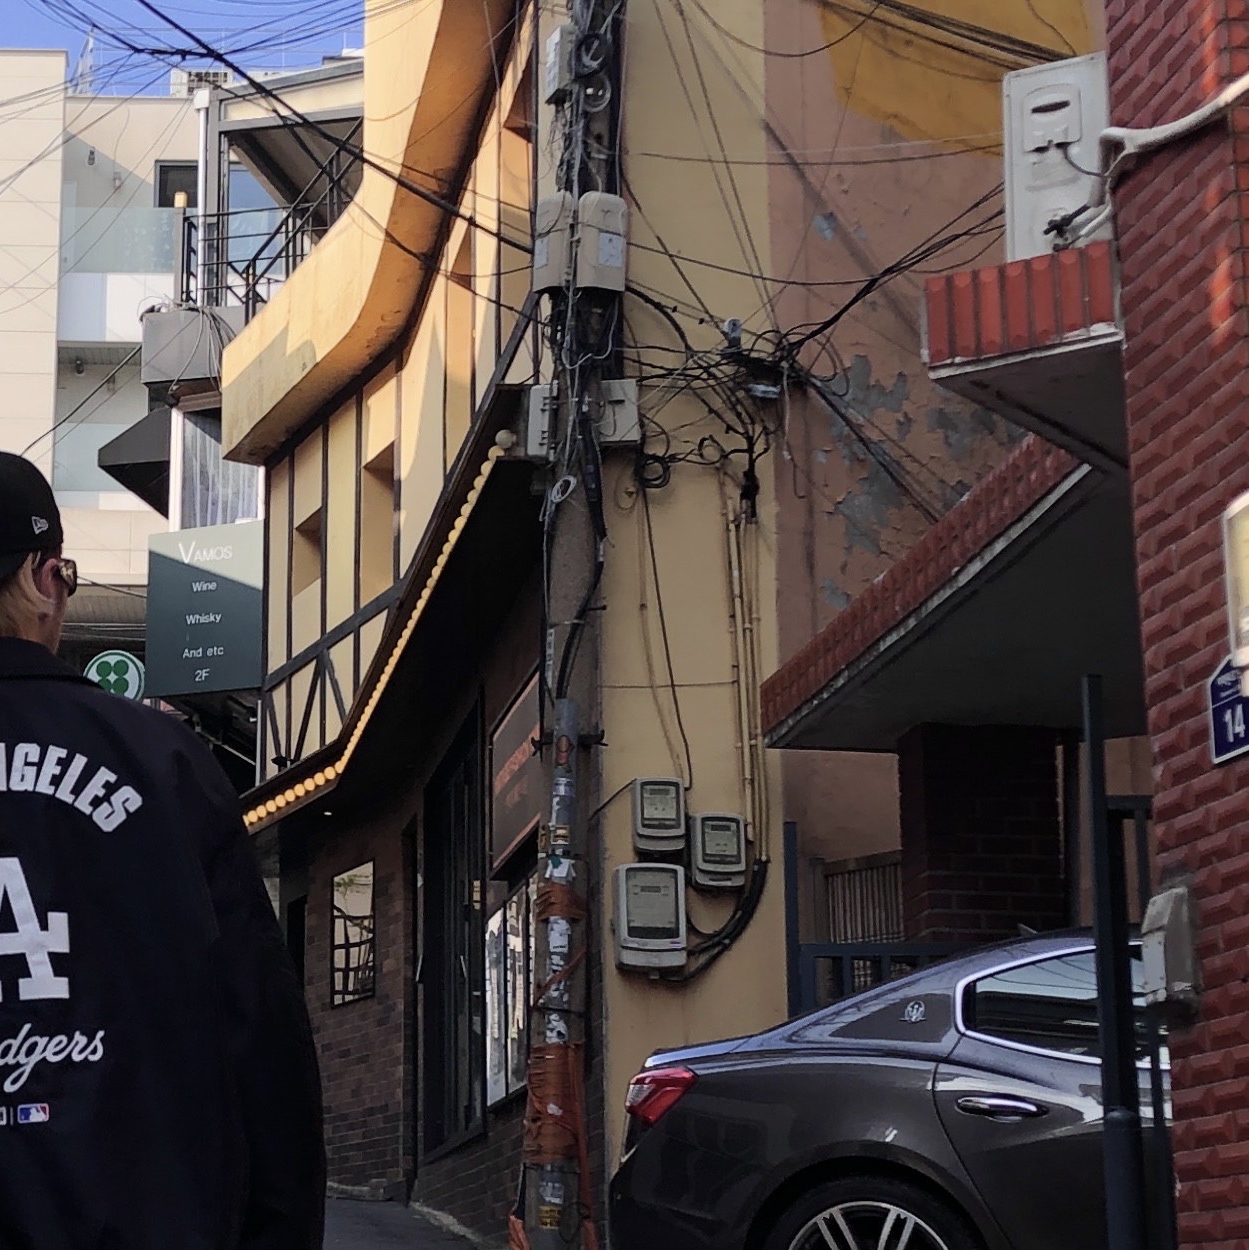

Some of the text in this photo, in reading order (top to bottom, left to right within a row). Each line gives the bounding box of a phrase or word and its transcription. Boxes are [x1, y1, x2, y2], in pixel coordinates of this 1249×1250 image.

[192, 581, 217, 592] Wine
[186, 612, 222, 625] Whisky
[182, 645, 224, 659] And etc
[195, 668, 210, 681] 2F
[1224, 703, 1246, 743] 14
